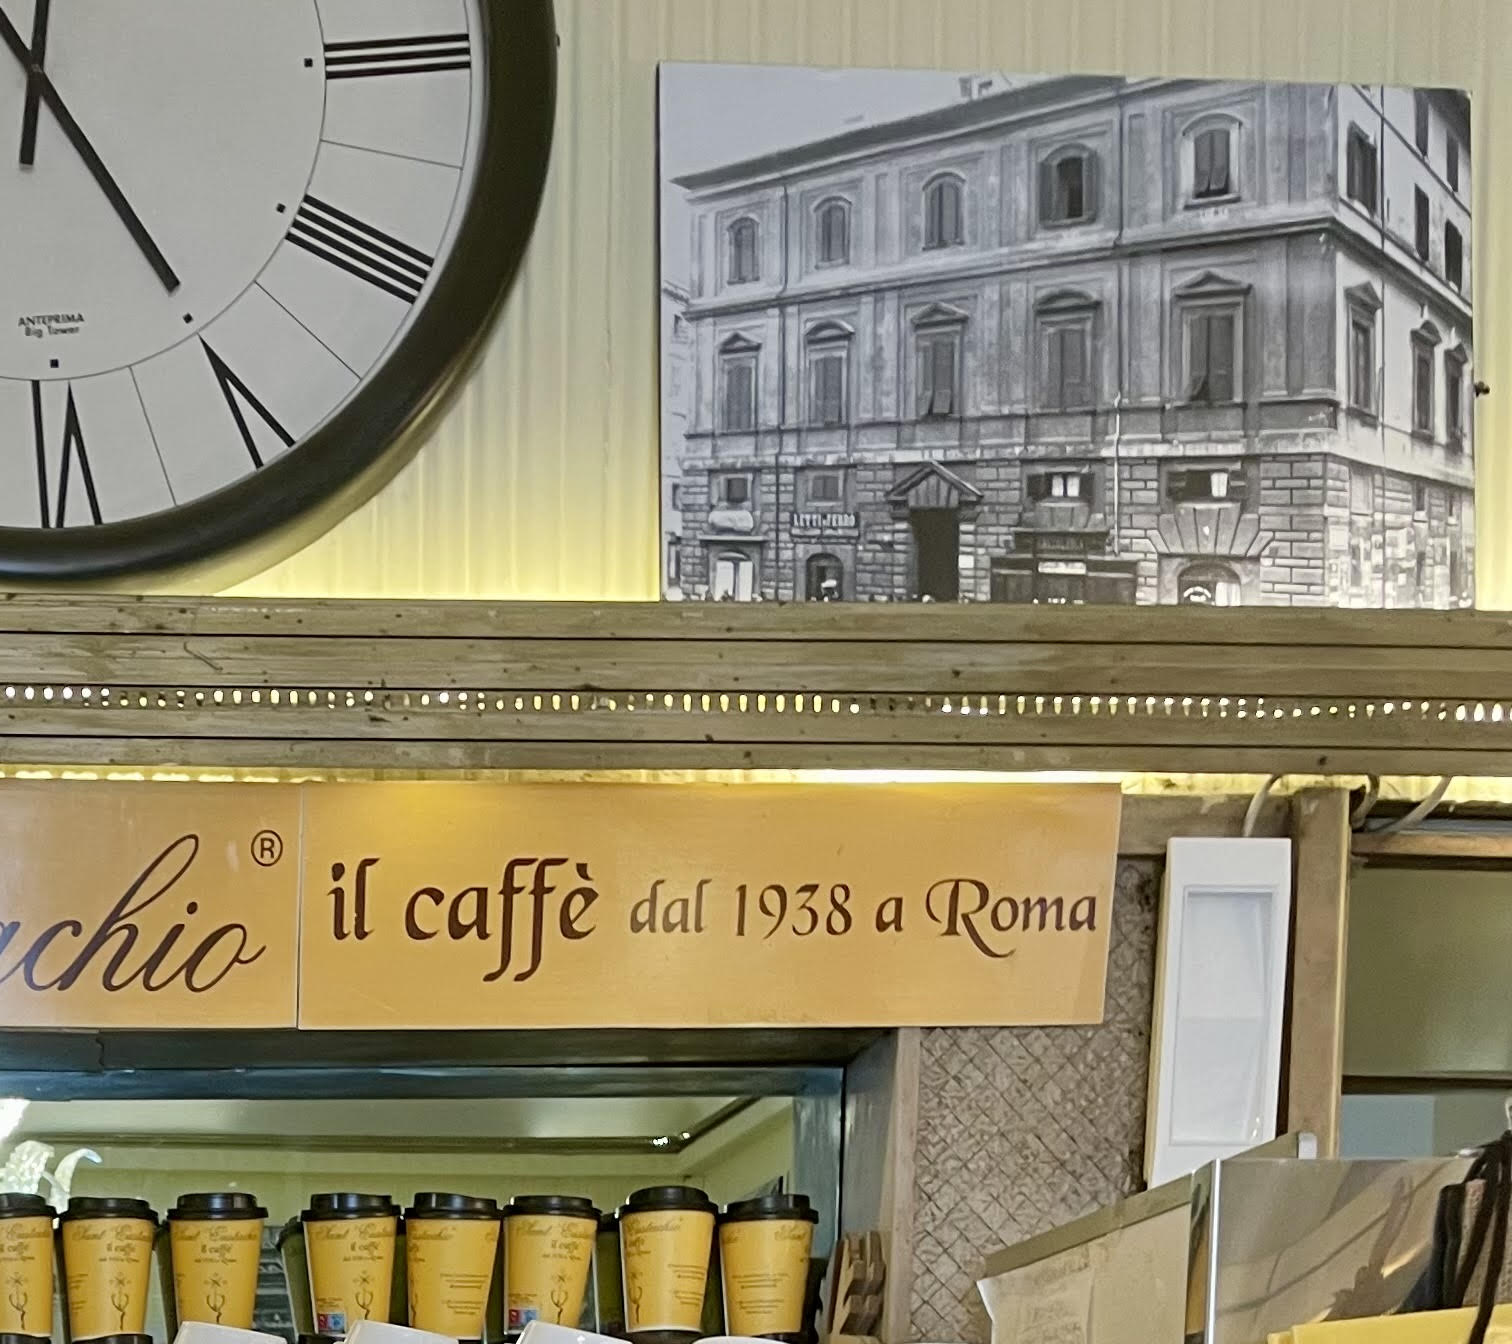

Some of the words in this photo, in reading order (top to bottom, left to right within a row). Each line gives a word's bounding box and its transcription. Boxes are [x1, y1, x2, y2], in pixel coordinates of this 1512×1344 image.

[330, 858, 381, 942] il
[404, 857, 598, 983] caffè
[628, 878, 712, 935] dal
[735, 881, 853, 939] 1938
[873, 892, 904, 935] a
[924, 877, 1099, 960] Roma
